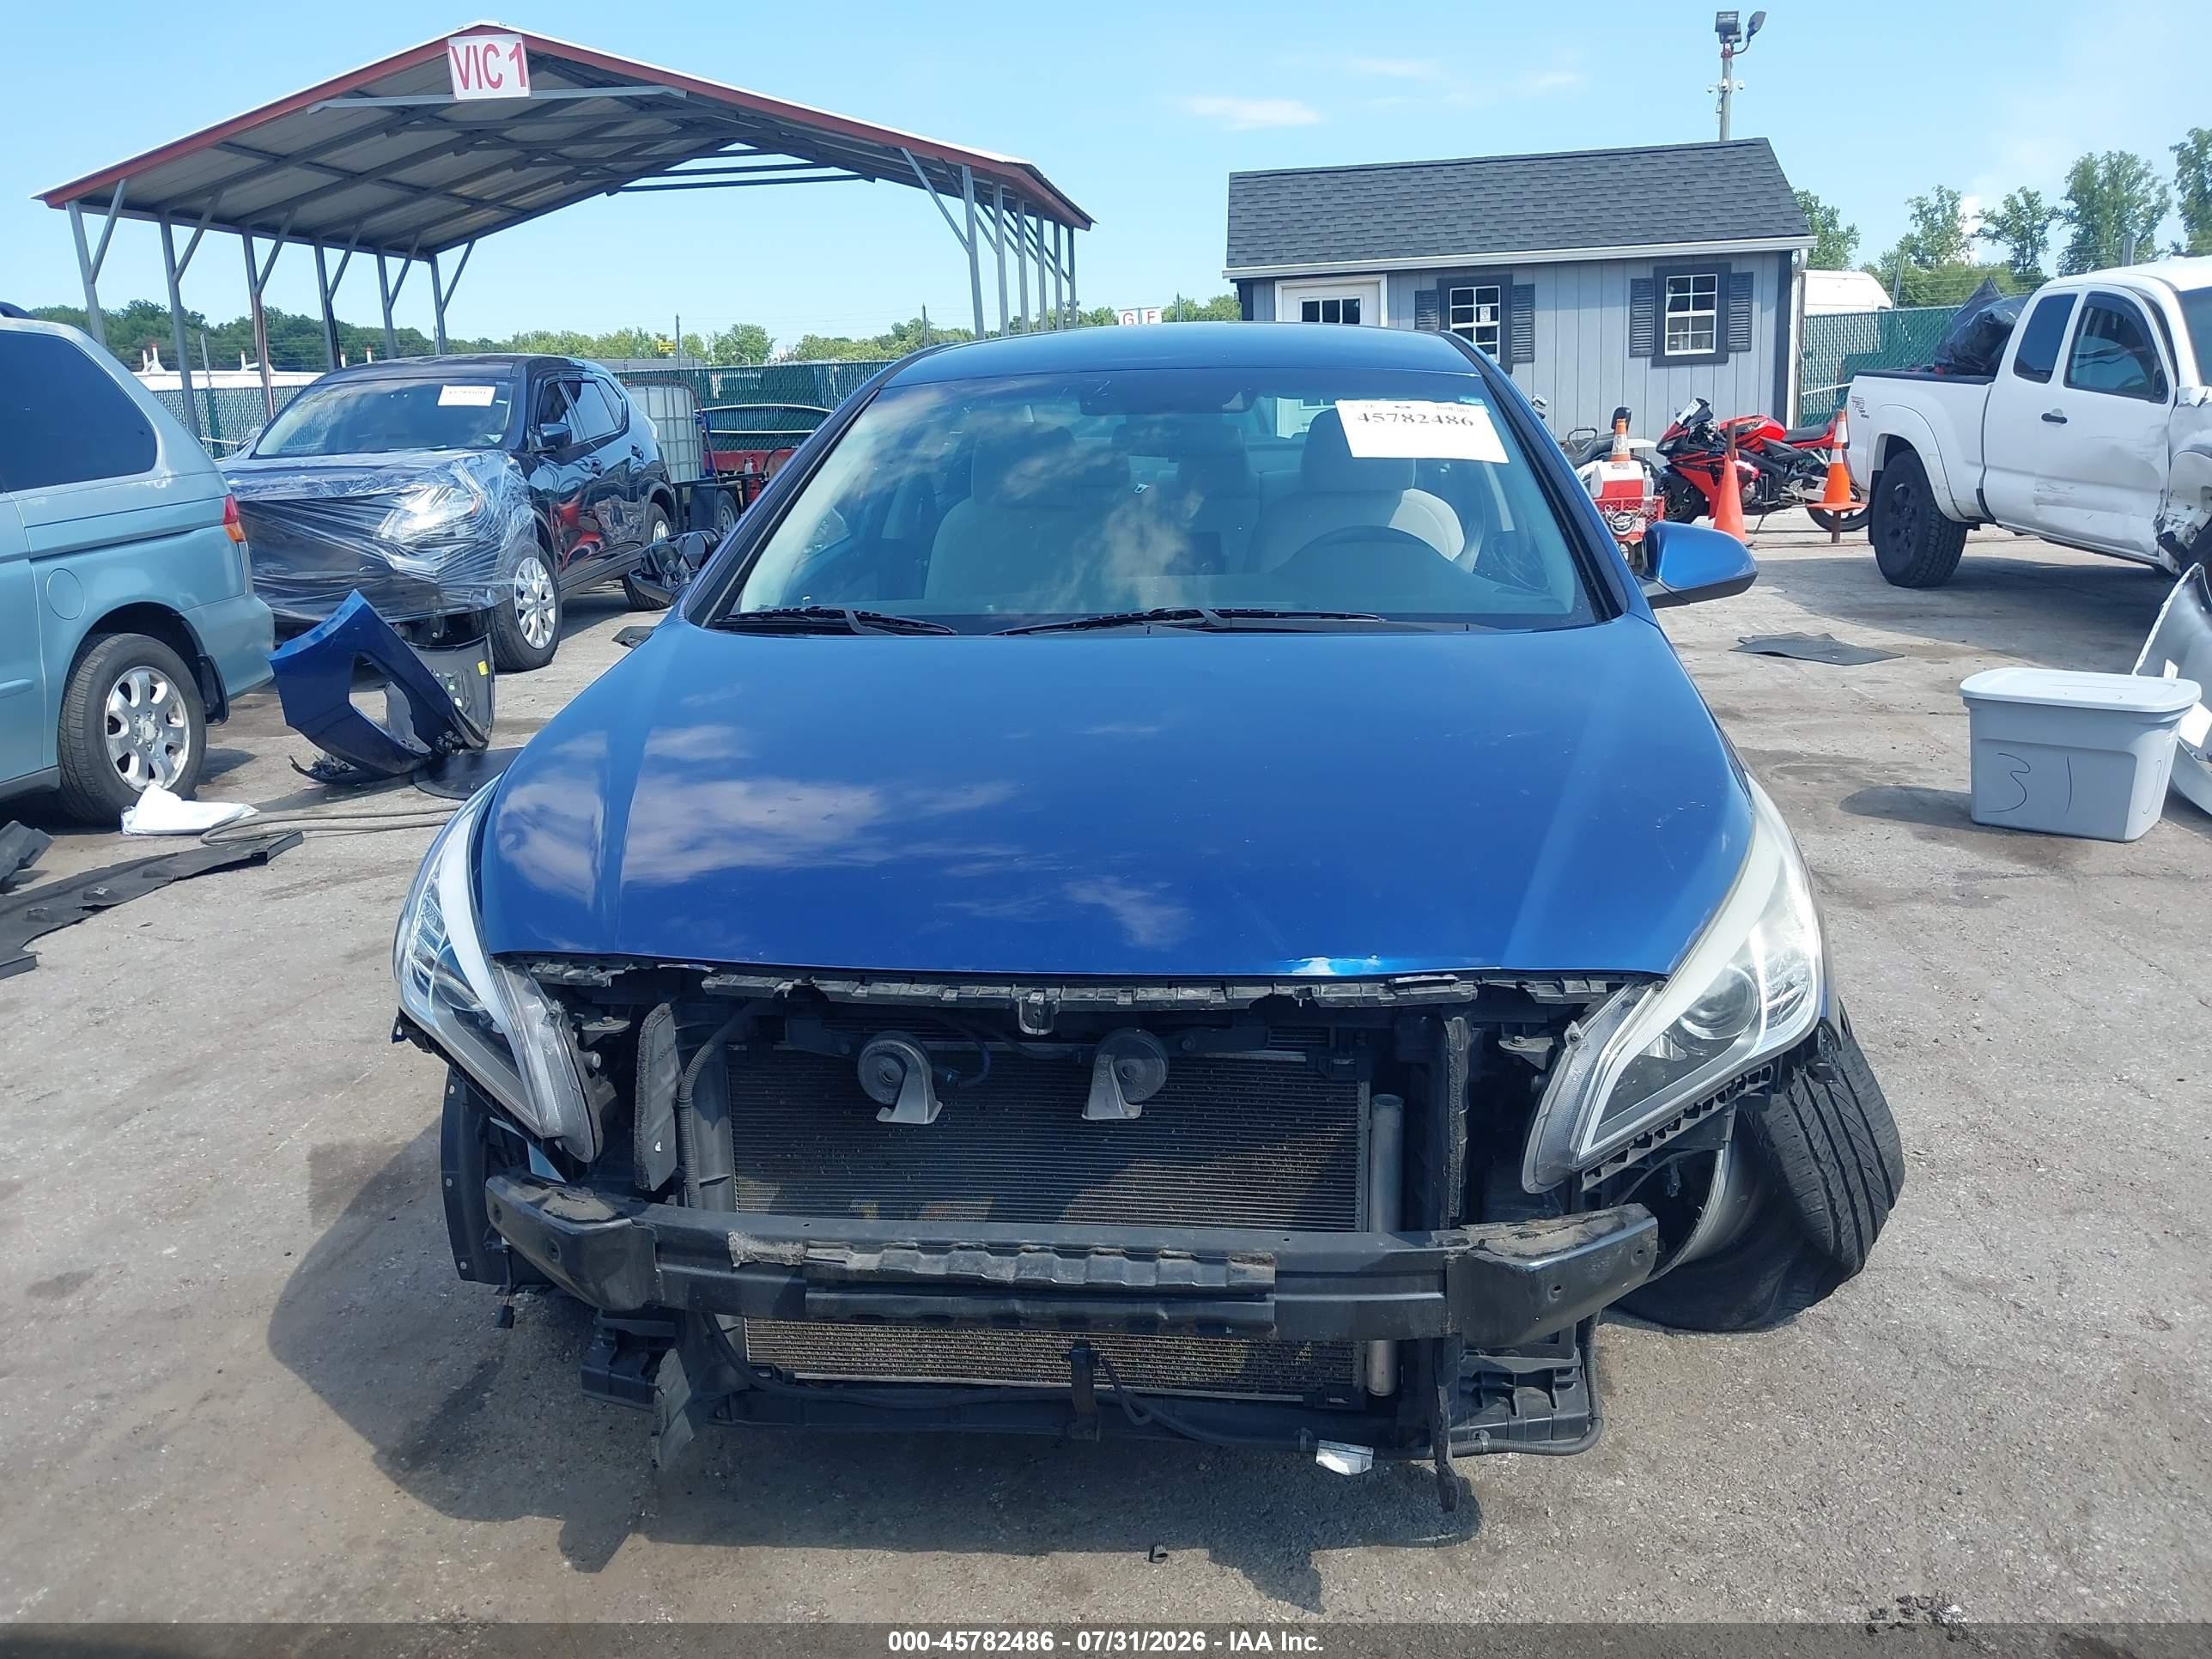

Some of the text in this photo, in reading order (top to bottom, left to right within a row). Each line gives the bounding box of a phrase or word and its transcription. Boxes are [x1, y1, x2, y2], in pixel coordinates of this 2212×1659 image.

[448, 42, 526, 90] VIC 1
[1357, 412, 1474, 427] 45782486
